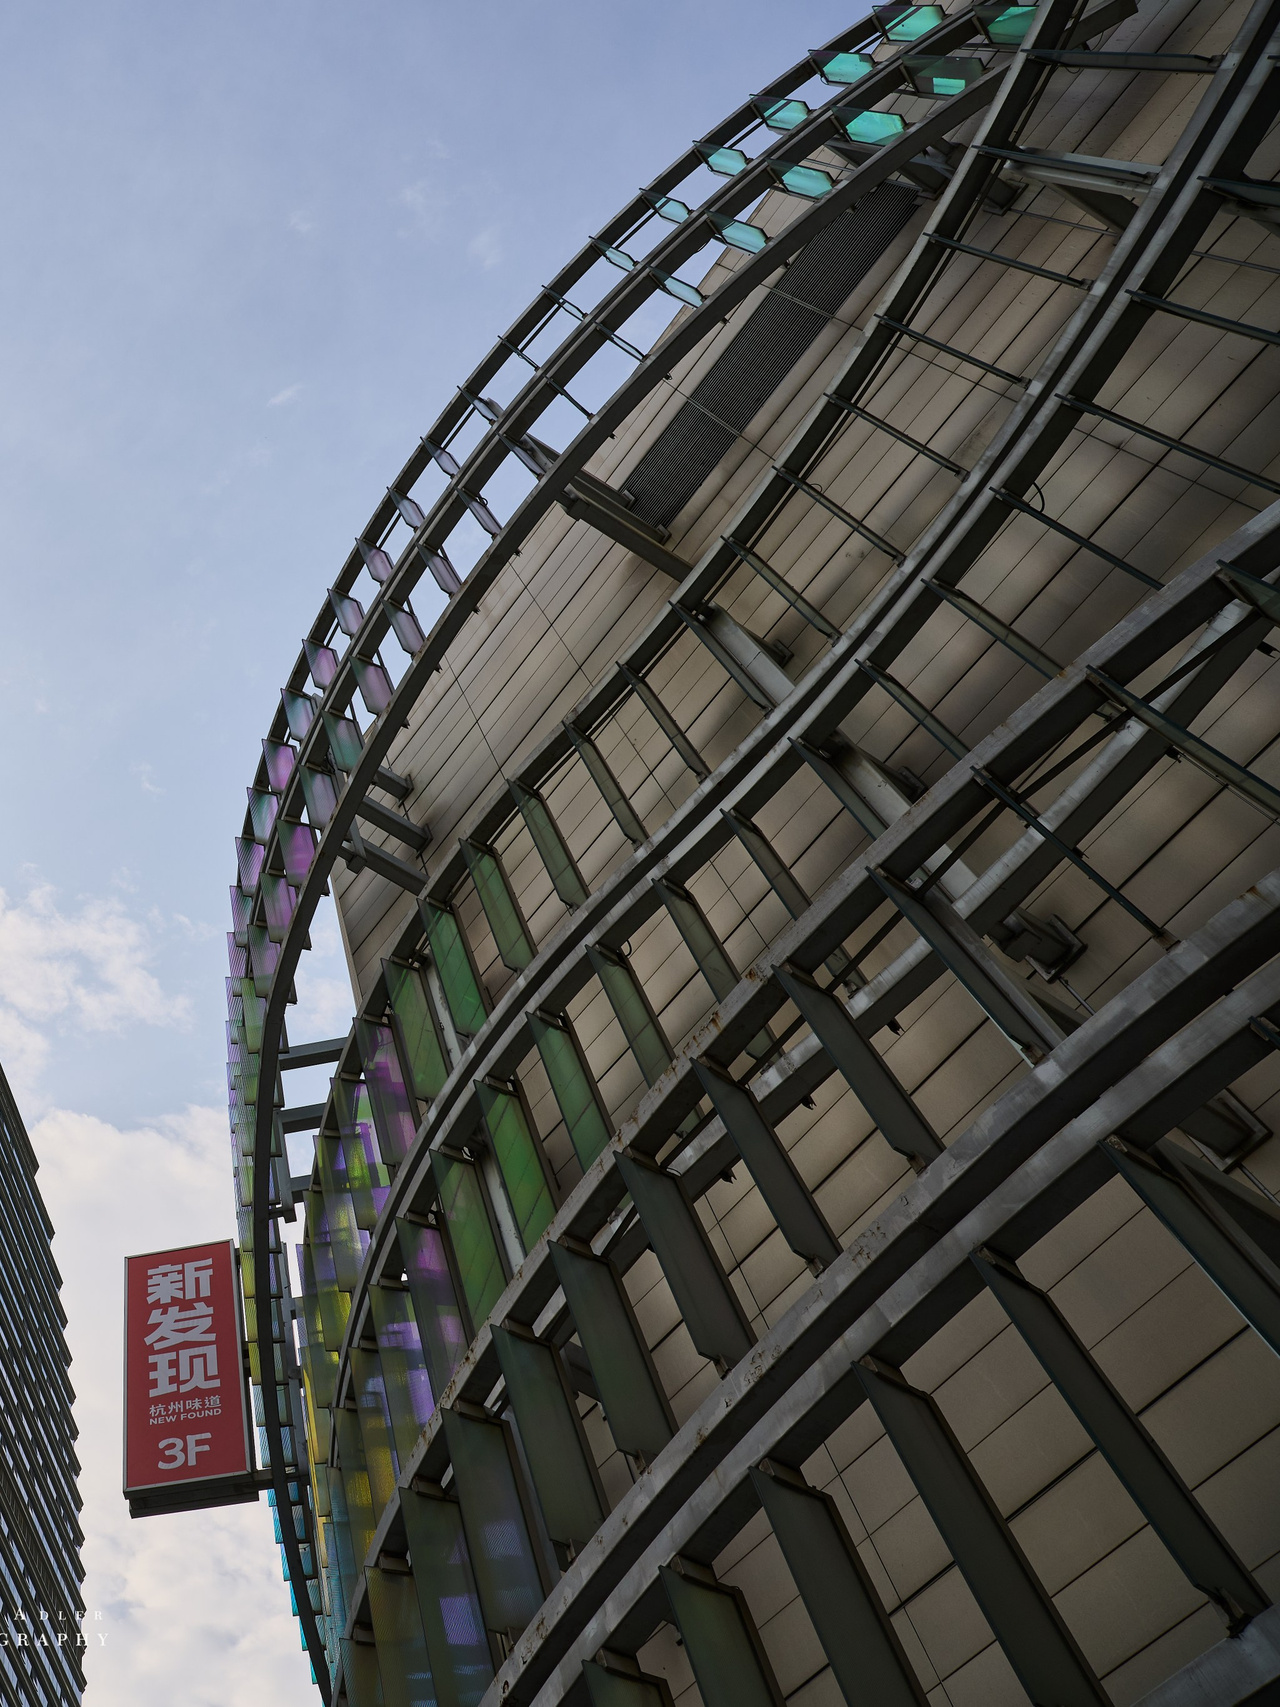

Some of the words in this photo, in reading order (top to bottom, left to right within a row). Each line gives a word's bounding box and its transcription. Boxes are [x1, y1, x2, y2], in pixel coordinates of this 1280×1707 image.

[144, 1258, 220, 1397] 新发现
[149, 1396, 221, 1416] 杭州味道
[149, 1414, 177, 1425] NEW
[181, 1408, 221, 1420] FOUND
[158, 1432, 211, 1469] 3F
